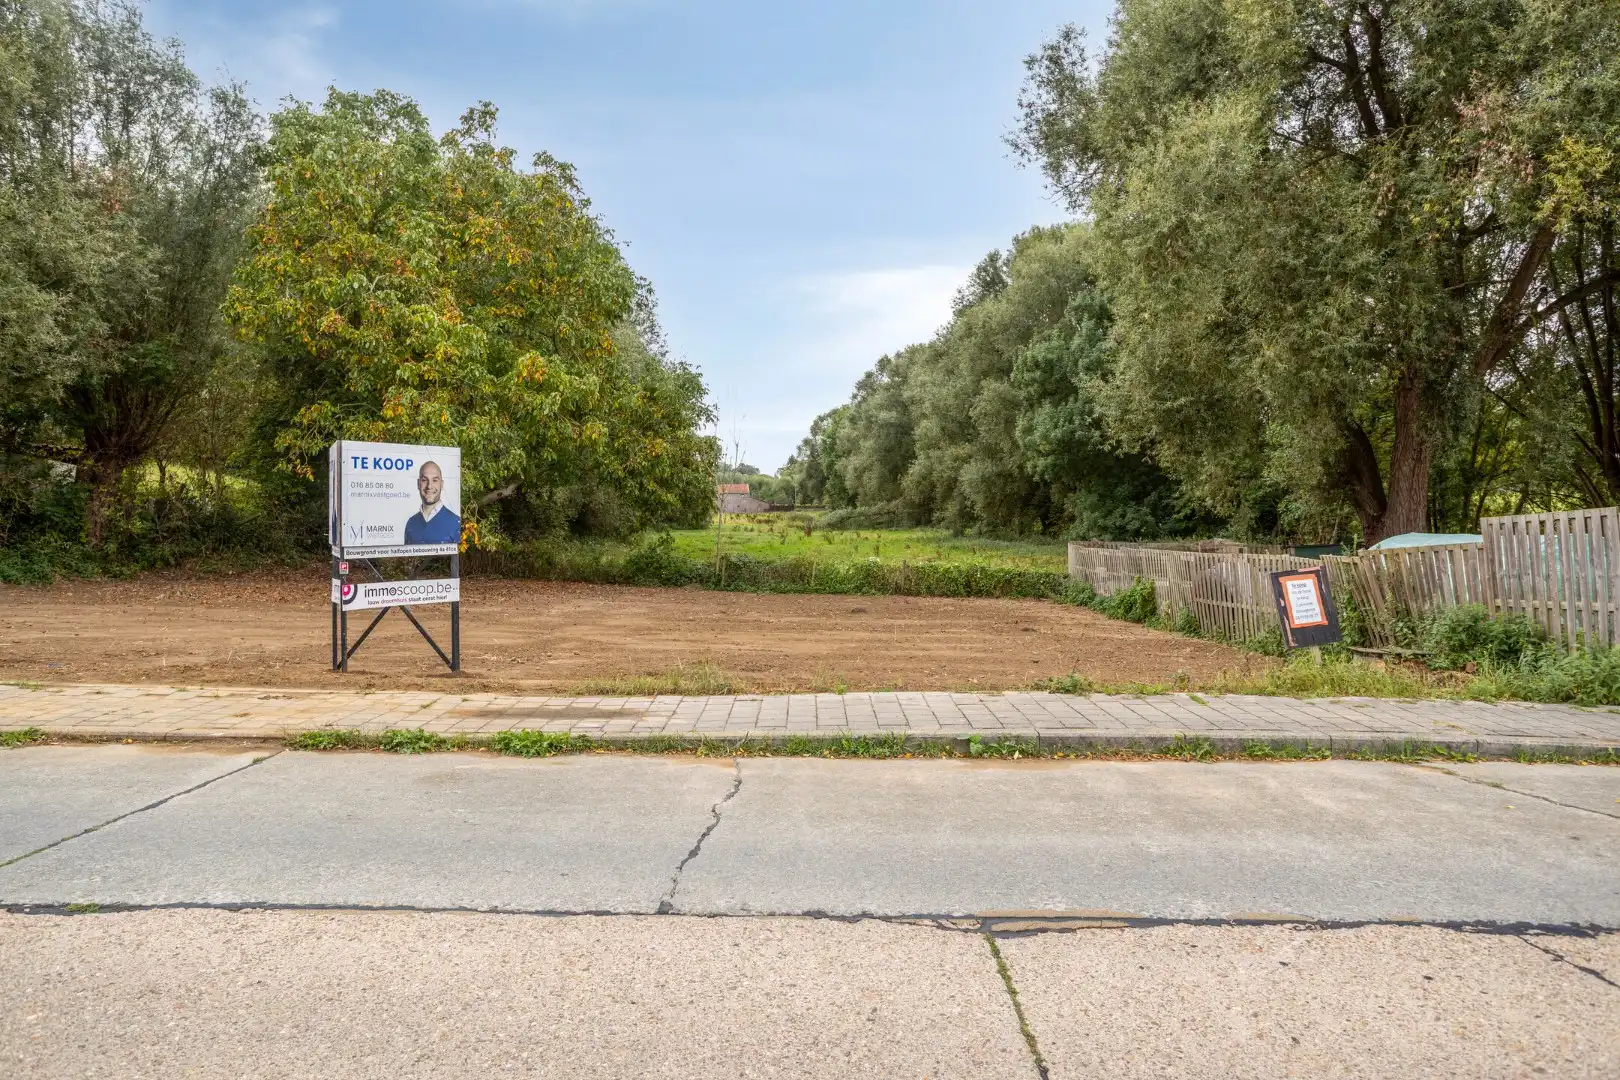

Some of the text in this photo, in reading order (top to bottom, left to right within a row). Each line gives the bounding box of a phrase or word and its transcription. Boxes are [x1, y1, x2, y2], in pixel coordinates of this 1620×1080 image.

[351, 456, 414, 470] TE KOOP
[364, 582, 452, 598] immoscoop.be
